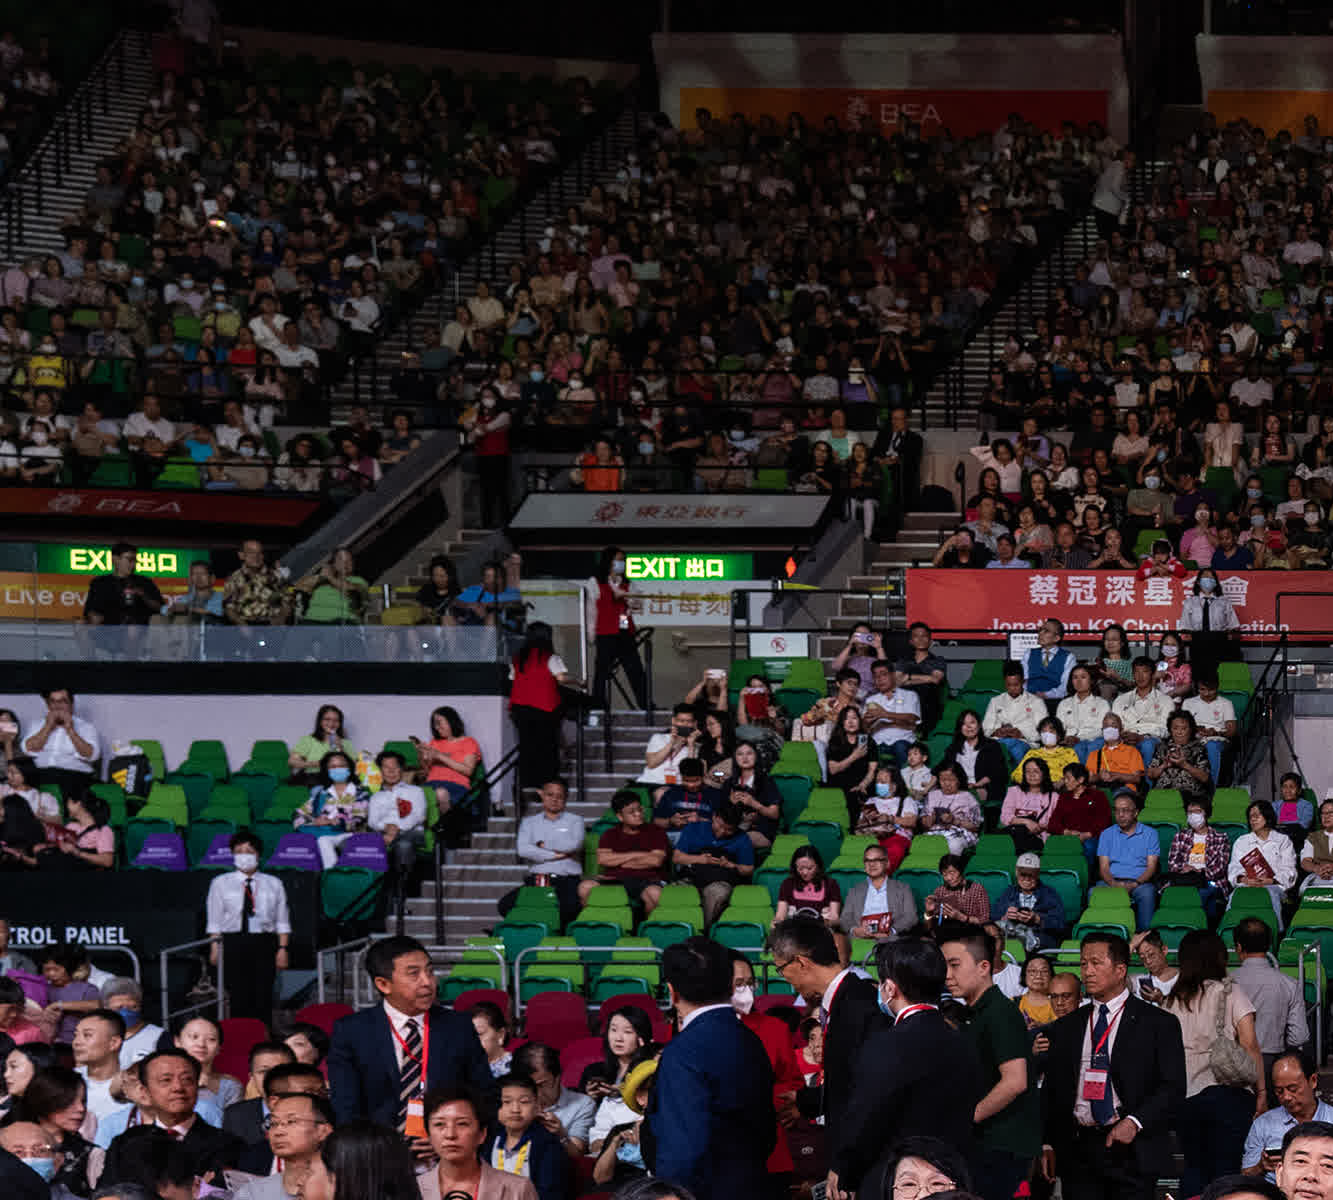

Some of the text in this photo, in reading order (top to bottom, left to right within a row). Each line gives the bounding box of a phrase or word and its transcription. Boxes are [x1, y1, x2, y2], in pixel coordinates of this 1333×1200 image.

[69, 548, 177, 572] EXI 出口
[626, 557, 724, 578] EXIT 出口
[65, 926, 130, 944] PANEL
